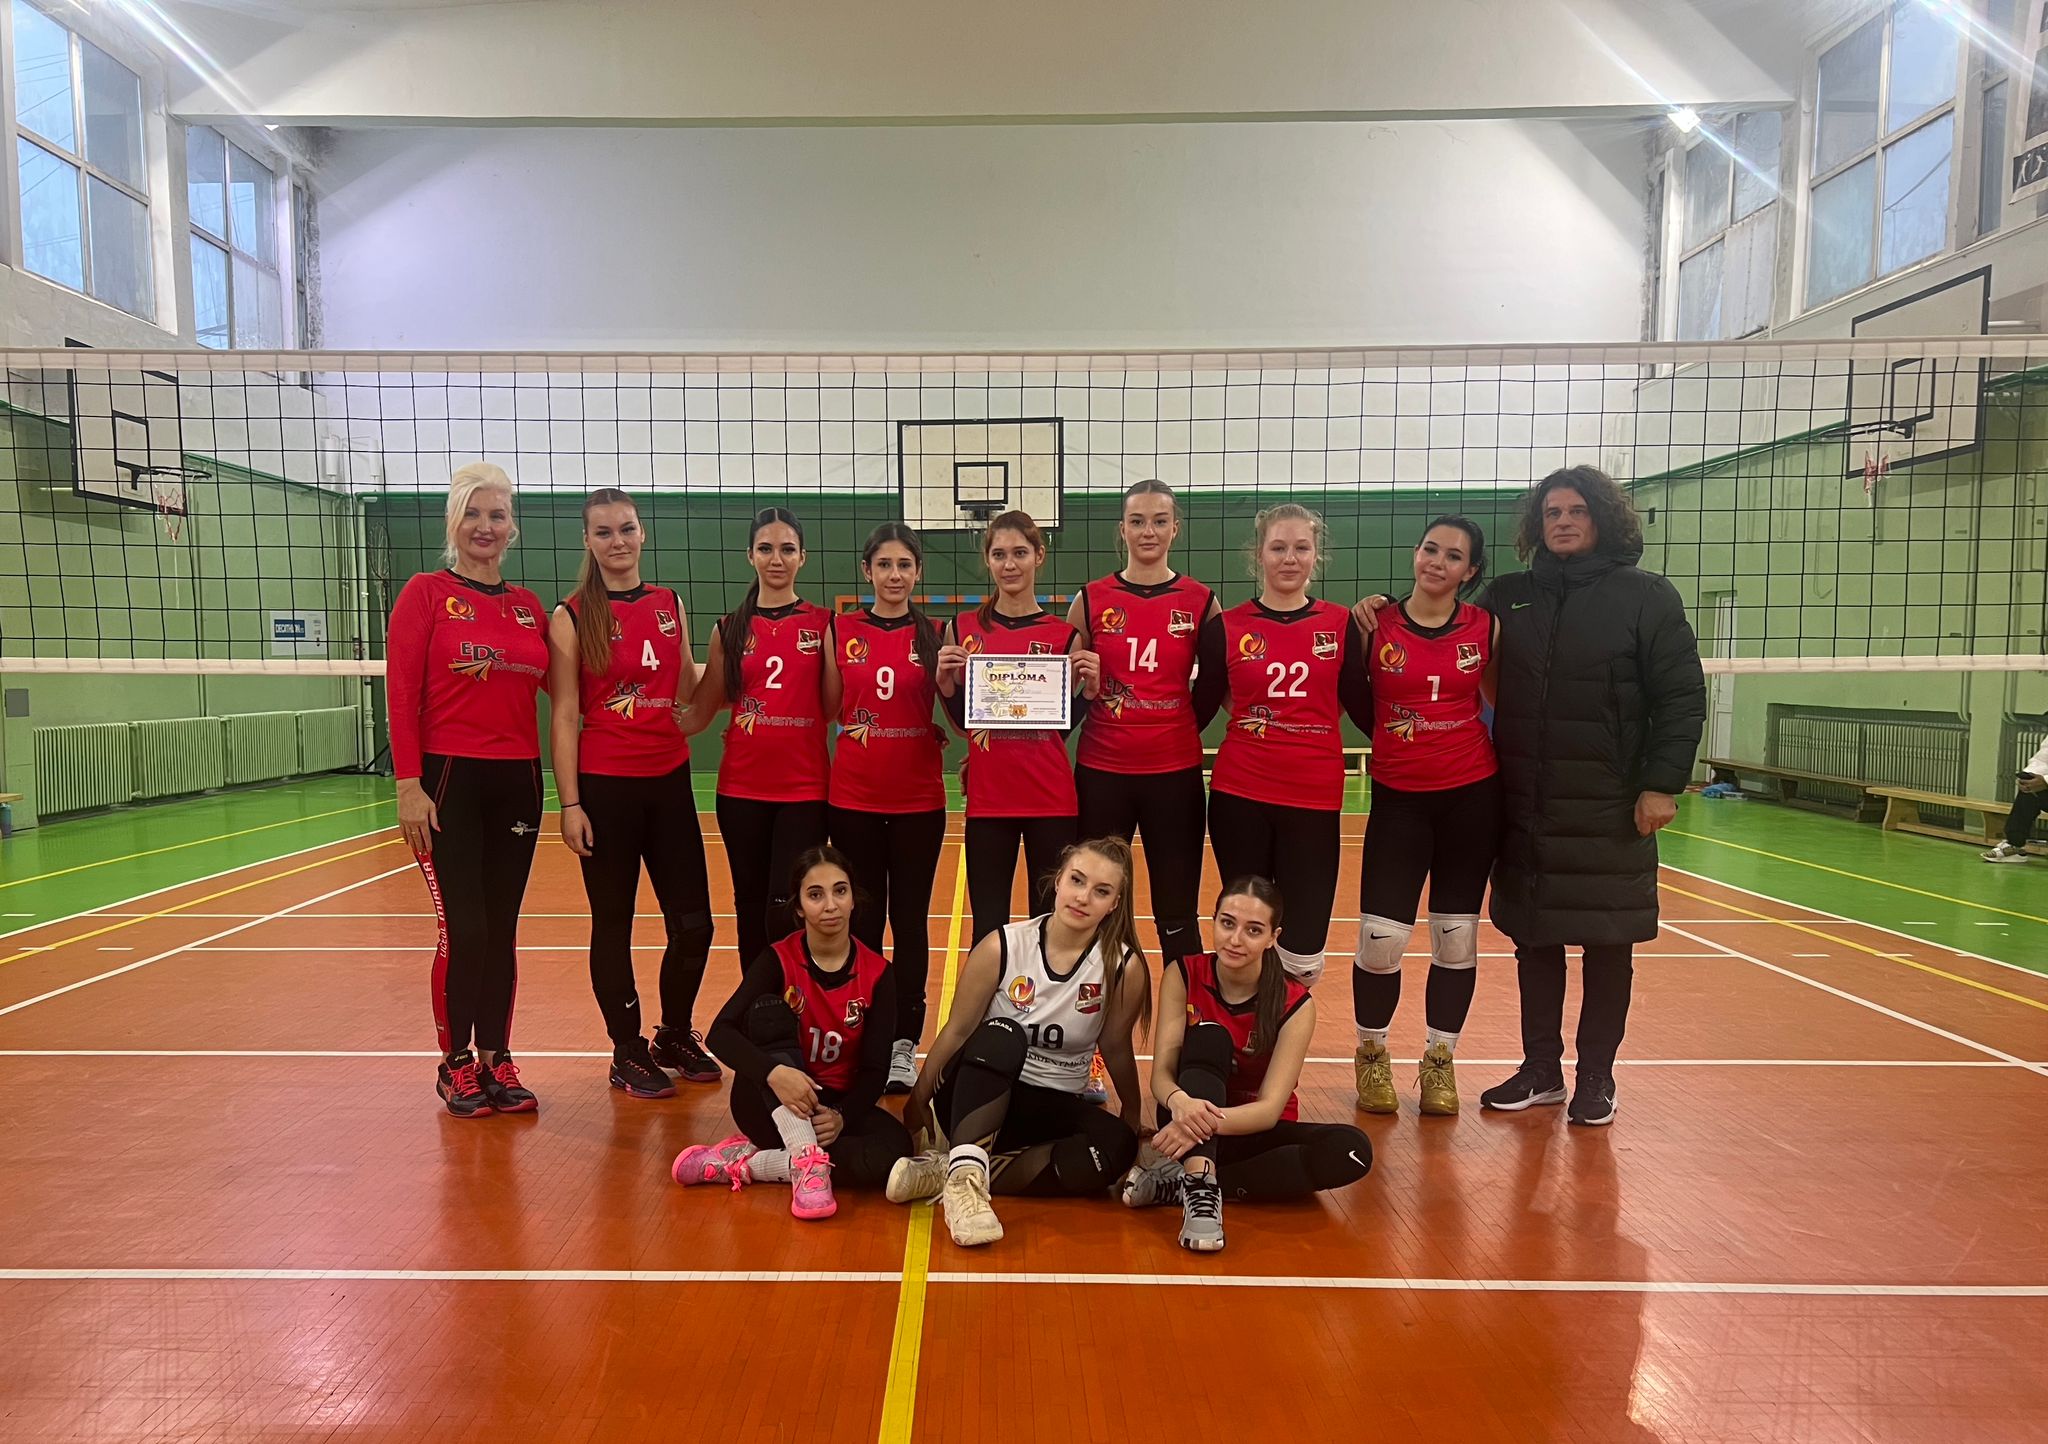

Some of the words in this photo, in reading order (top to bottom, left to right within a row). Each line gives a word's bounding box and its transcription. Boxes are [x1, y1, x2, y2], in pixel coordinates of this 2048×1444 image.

[460, 641, 506, 662] EDC
[641, 639, 660, 671] 4
[1126, 637, 1158, 672] 14
[765, 655, 783, 689] 2
[876, 666, 895, 700] 9
[989, 673, 1047, 682] DIPLOMA
[1266, 661, 1309, 698] 22
[809, 1026, 842, 1063] 18
[1027, 1023, 1064, 1049] 19
